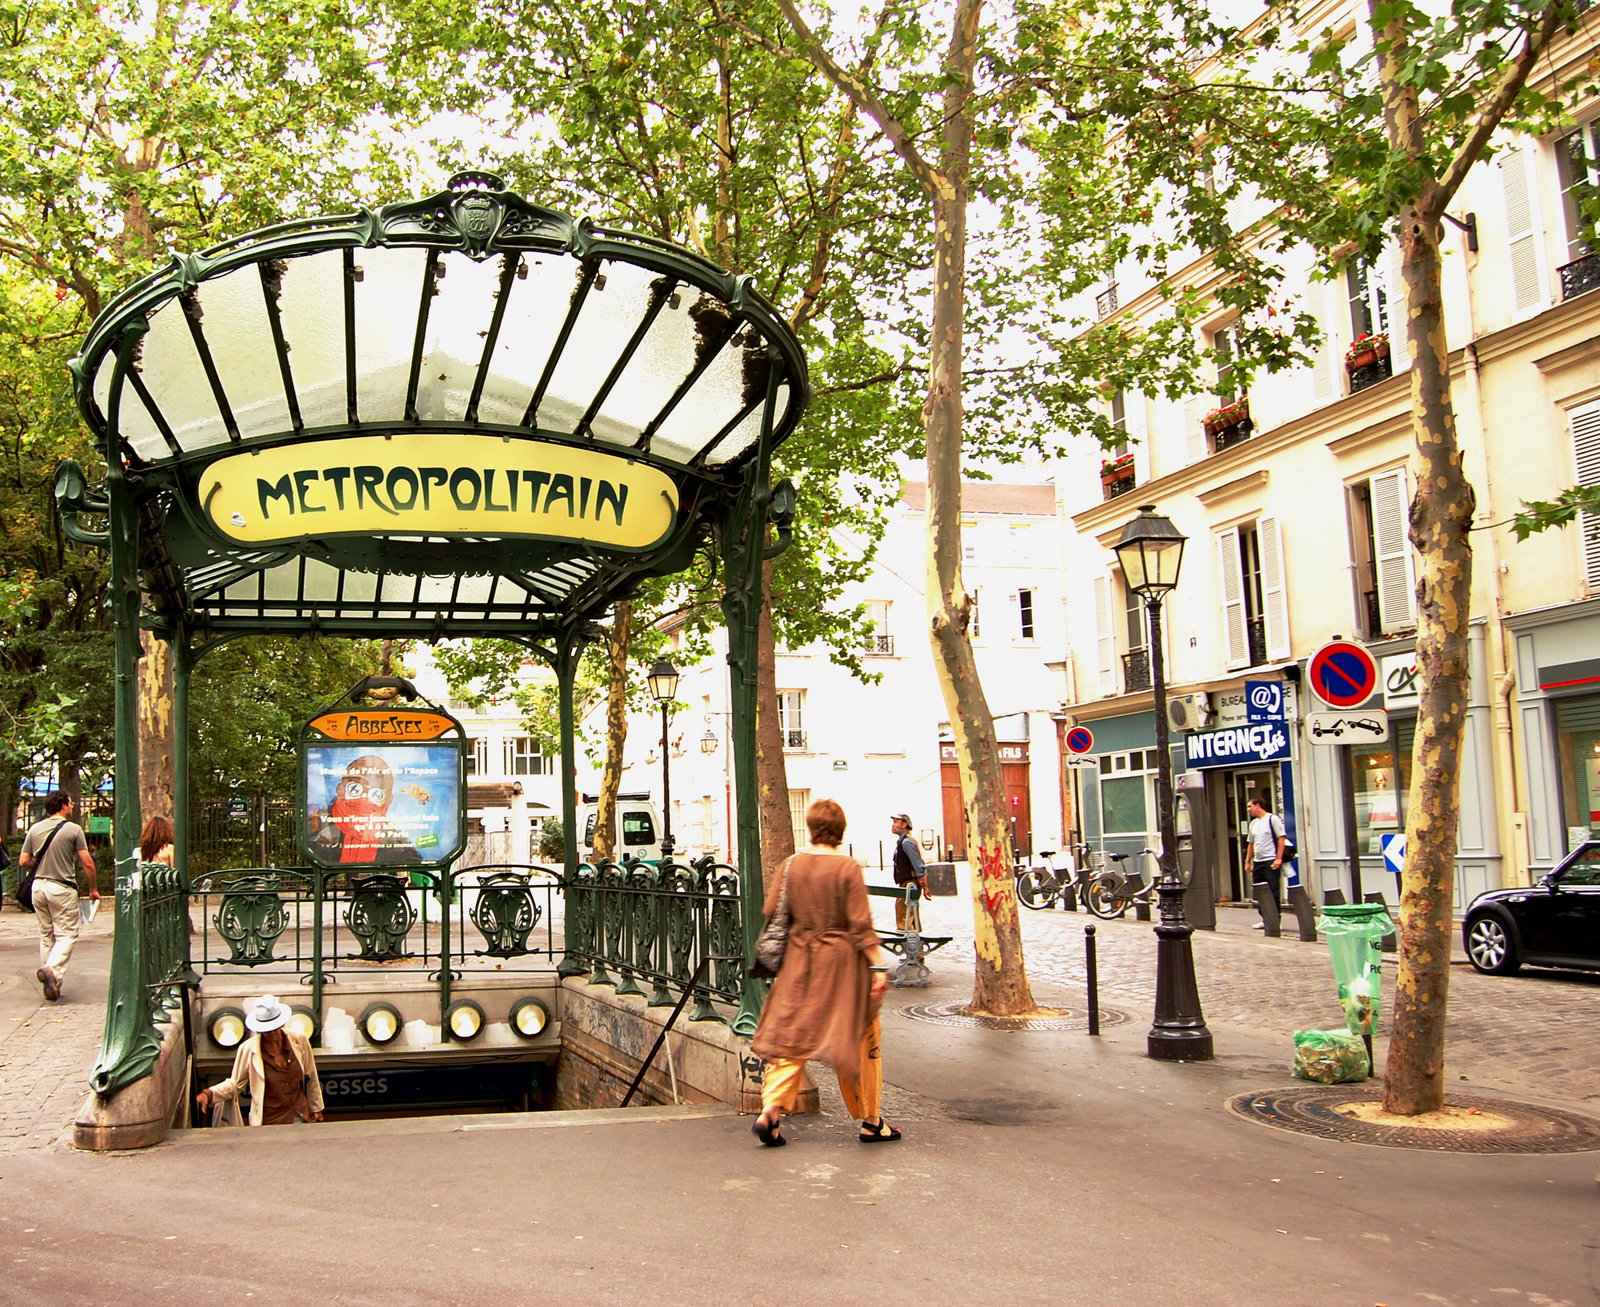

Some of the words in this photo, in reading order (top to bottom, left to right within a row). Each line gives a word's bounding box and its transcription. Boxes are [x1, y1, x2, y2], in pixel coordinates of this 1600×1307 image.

[256, 465, 629, 526] METROPOLITAIN
[345, 715, 422, 736] ABBESSES
[1188, 725, 1273, 760] INTERNET
[1002, 747, 1022, 759] FILS
[320, 815, 342, 823] Vous
[319, 1077, 388, 1096] esses
